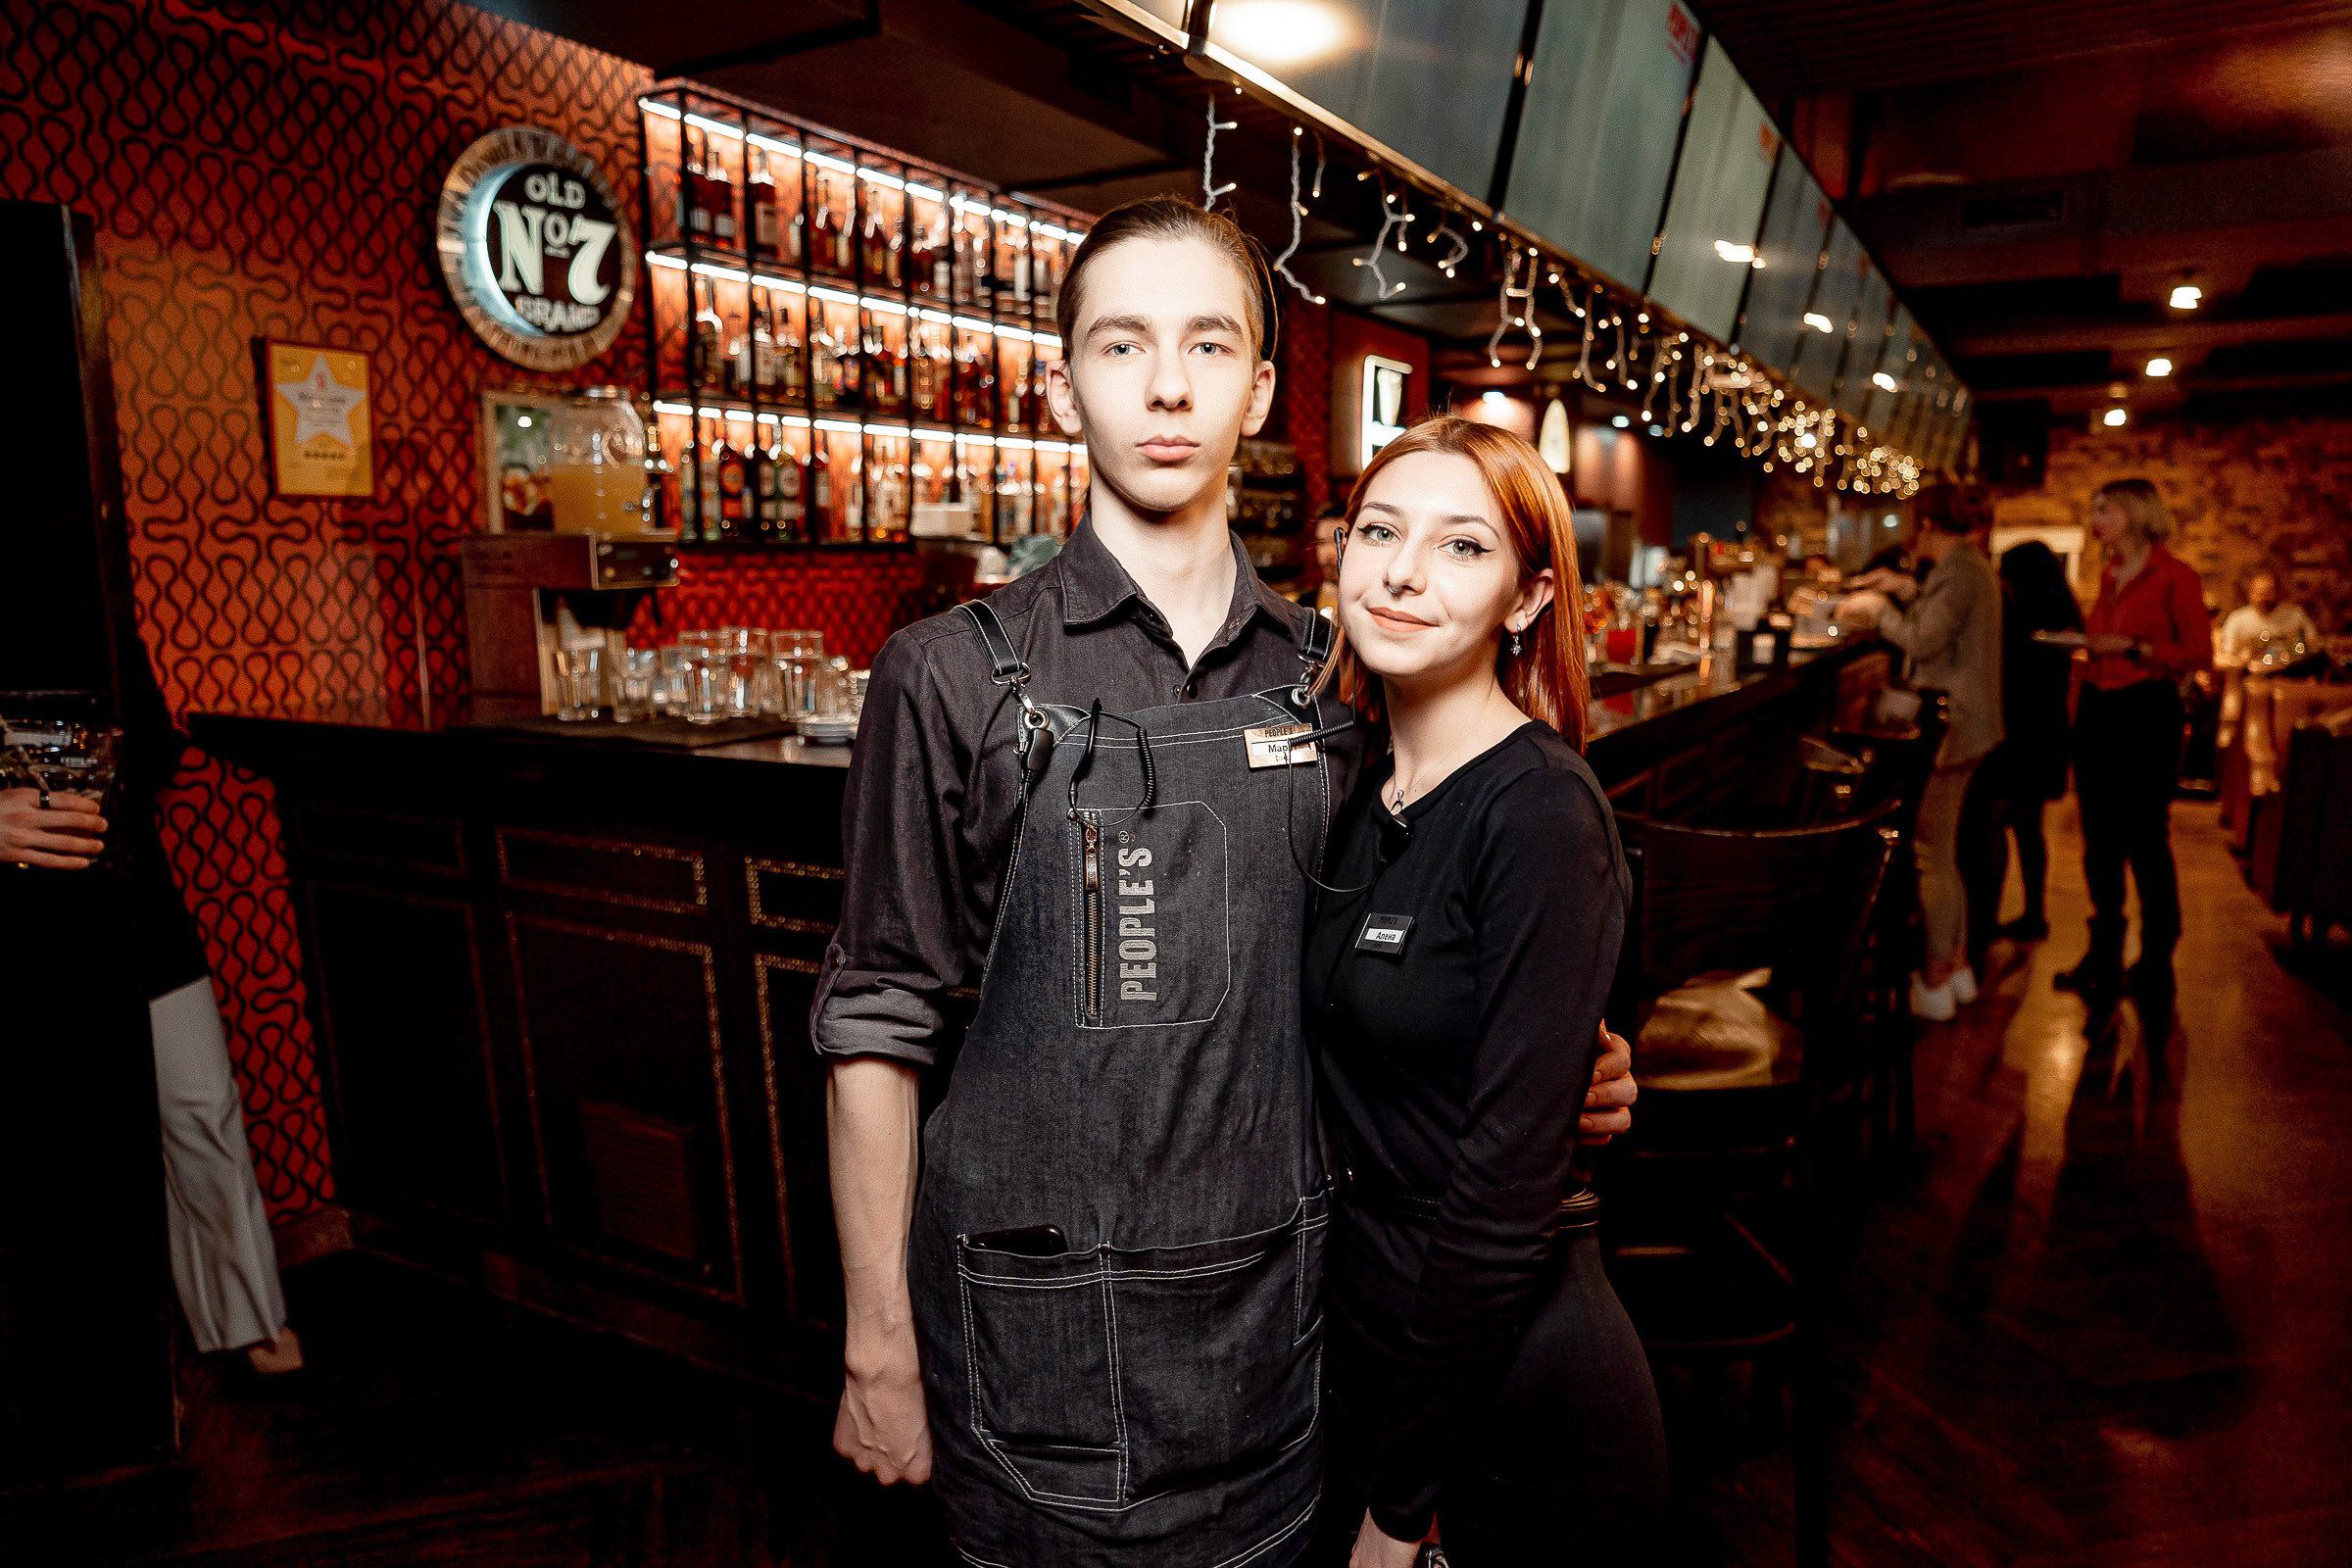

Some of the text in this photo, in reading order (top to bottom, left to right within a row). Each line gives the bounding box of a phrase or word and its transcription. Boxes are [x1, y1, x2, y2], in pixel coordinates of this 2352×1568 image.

[524, 172, 585, 209] OLD
[1264, 727, 1294, 737] PEOPLES
[1375, 931, 1396, 941] Алена
